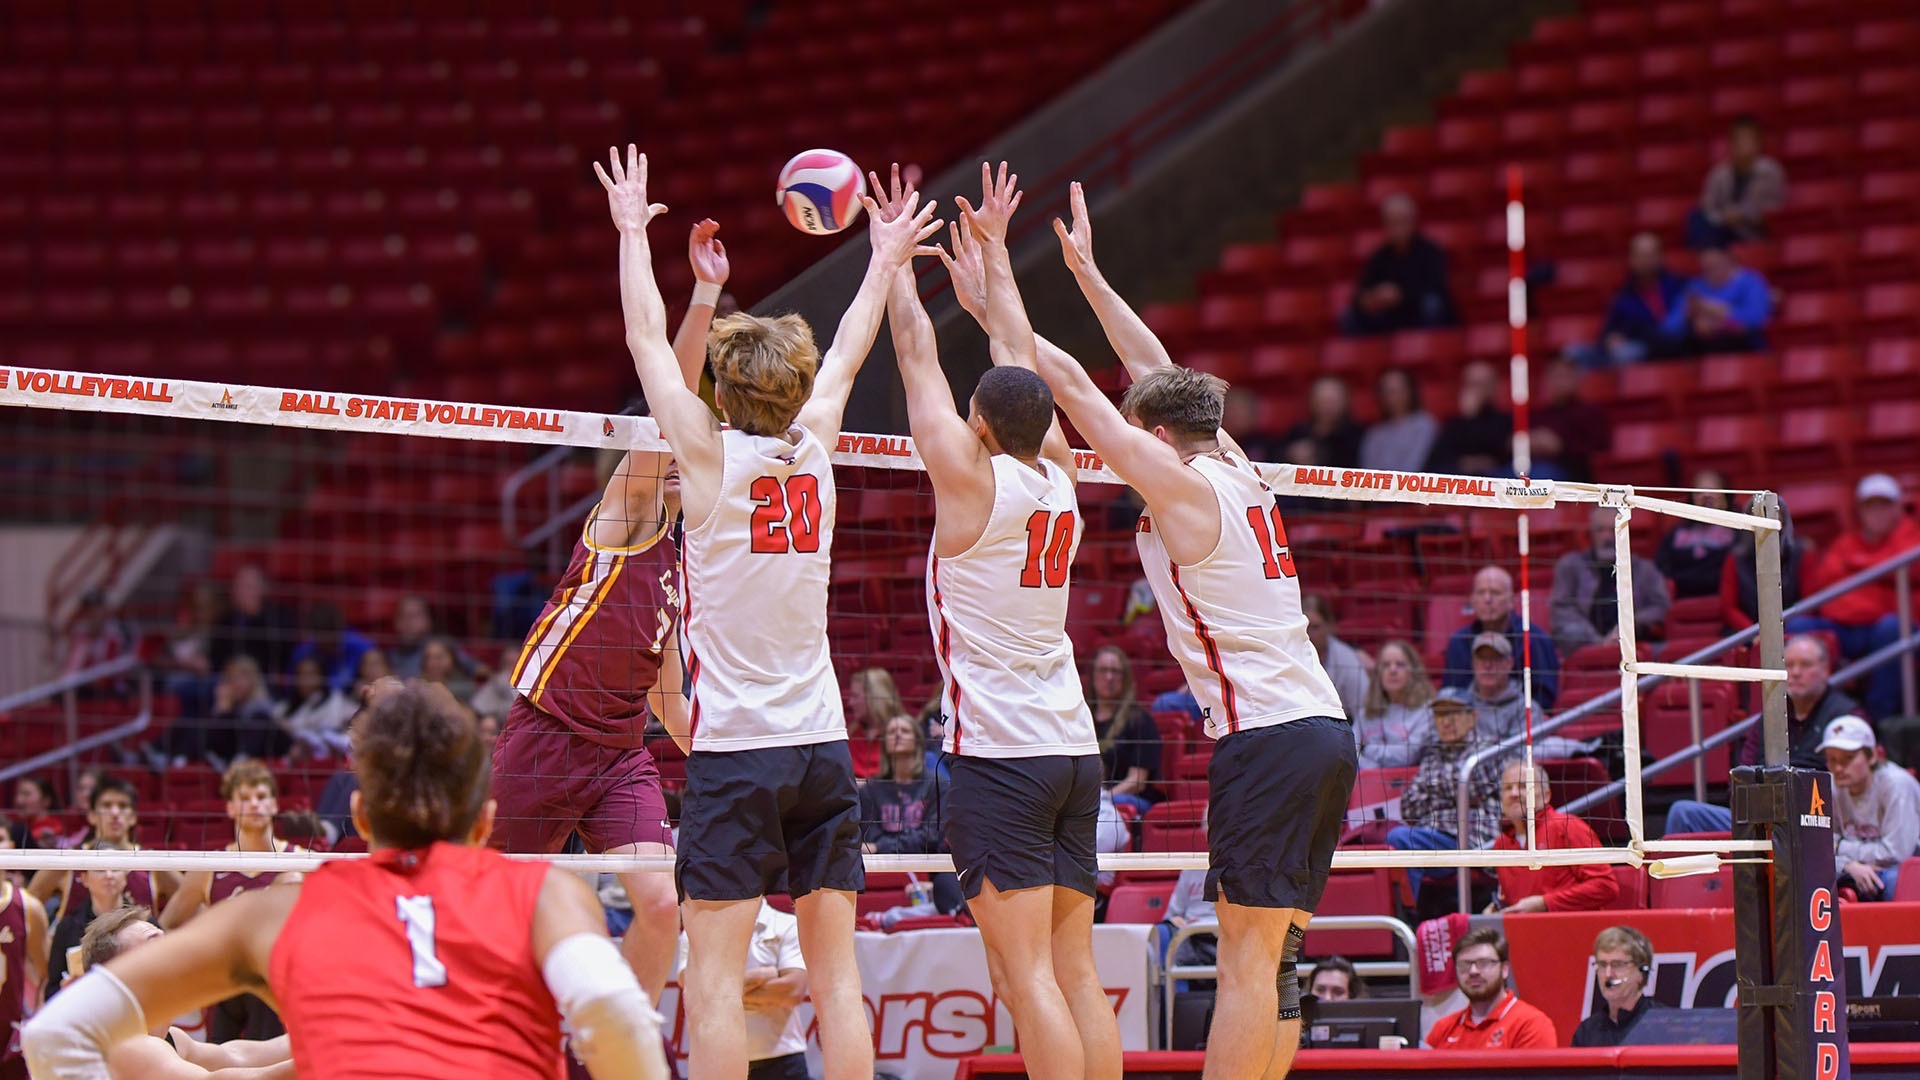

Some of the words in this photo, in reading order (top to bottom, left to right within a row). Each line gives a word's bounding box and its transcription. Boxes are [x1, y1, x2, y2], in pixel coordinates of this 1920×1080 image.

[16, 370, 174, 403] VOLLEYBALL
[279, 392, 340, 415] BALL
[345, 398, 419, 421] STATE
[423, 403, 565, 432] VOLLEYBALL
[835, 434, 913, 457] EYBALL
[1294, 468, 1336, 487] BALL
[1340, 471, 1393, 490] STATE
[1397, 475, 1496, 497] VOLLEYBALL
[1505, 486, 1528, 496] ACTIVE
[1529, 487, 1548, 496] ANKLE
[750, 473, 822, 554] 20
[1020, 510, 1075, 588] 10
[1800, 814, 1817, 828] ACTIVE
[395, 894, 448, 988] 1
